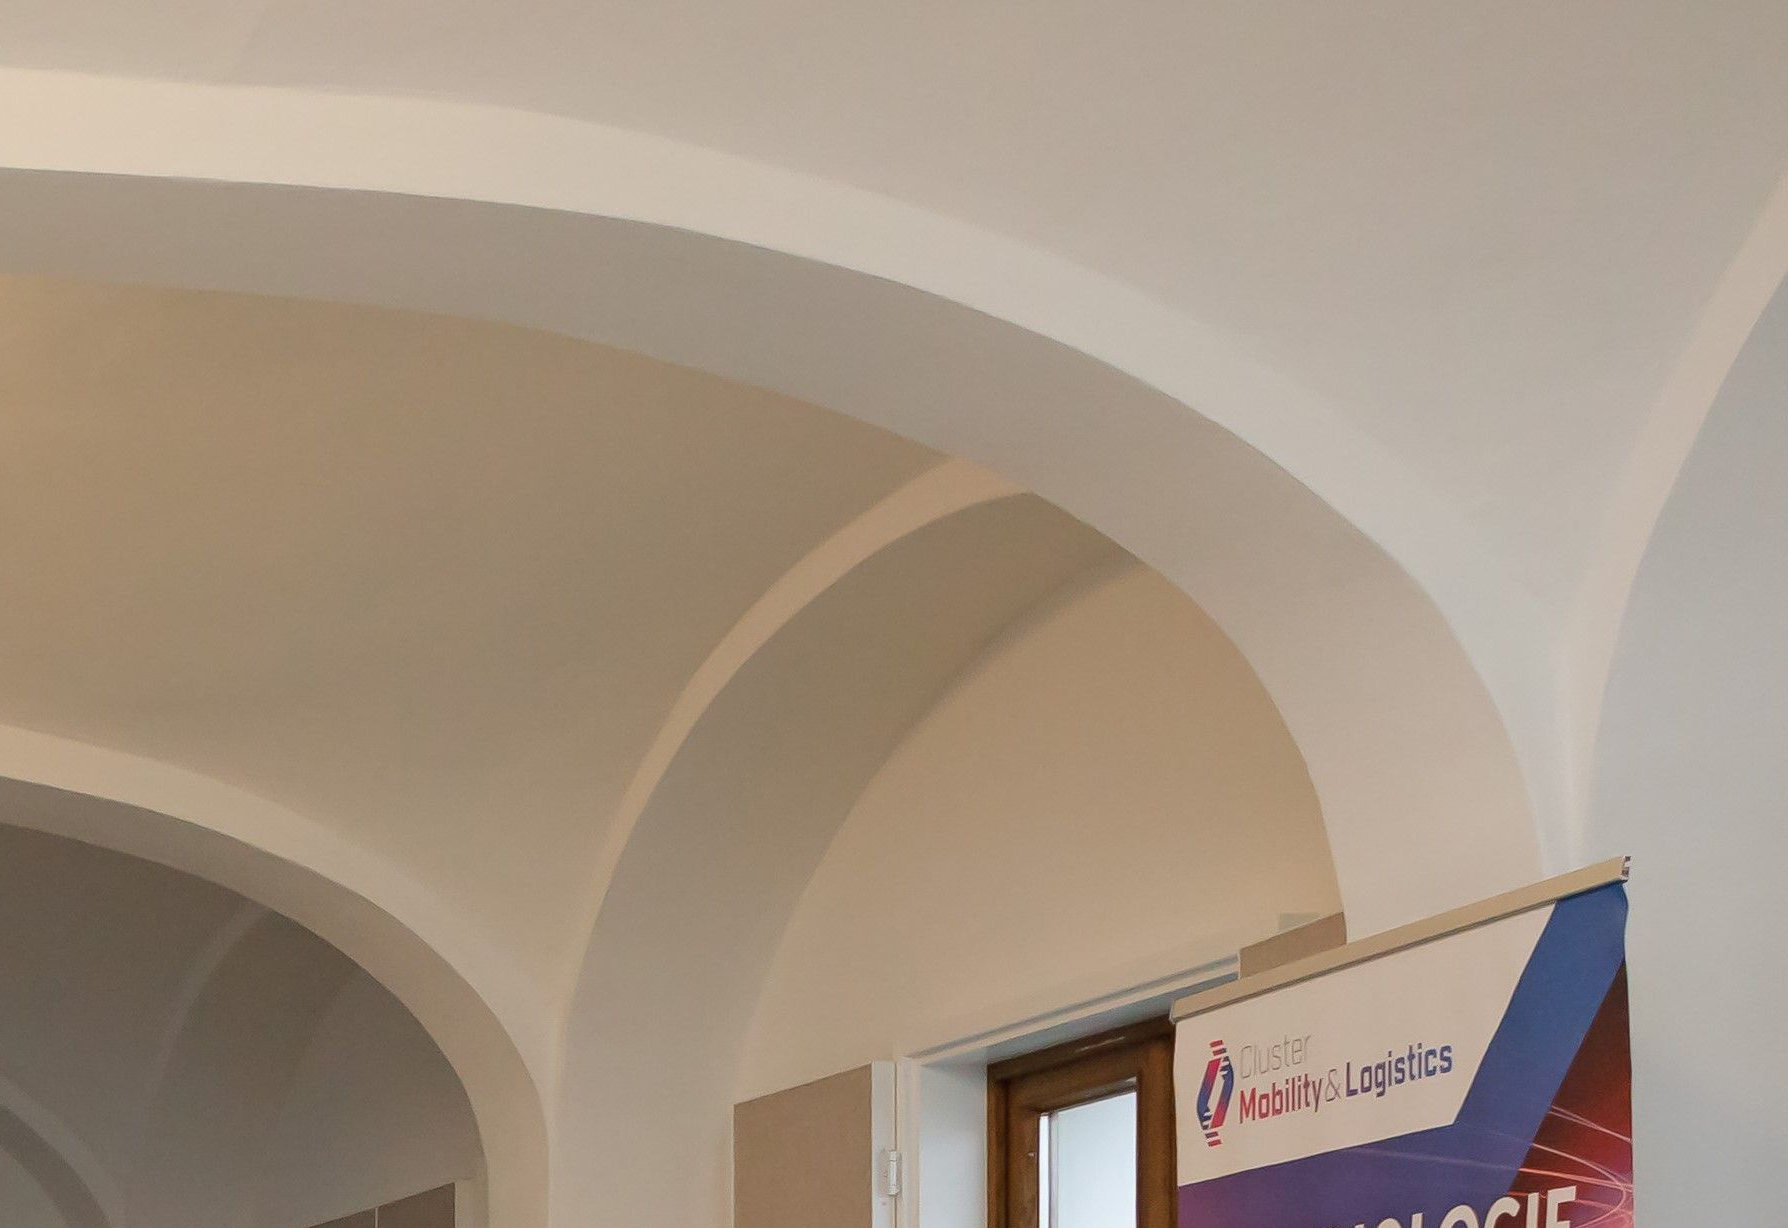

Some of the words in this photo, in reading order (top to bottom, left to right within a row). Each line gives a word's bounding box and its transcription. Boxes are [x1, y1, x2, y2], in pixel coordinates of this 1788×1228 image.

[1239, 1035, 1311, 1080] Cluster
[1239, 1073, 1323, 1125] Mobility
[1324, 1069, 1341, 1102] &
[1346, 1042, 1453, 1098] Logistics
